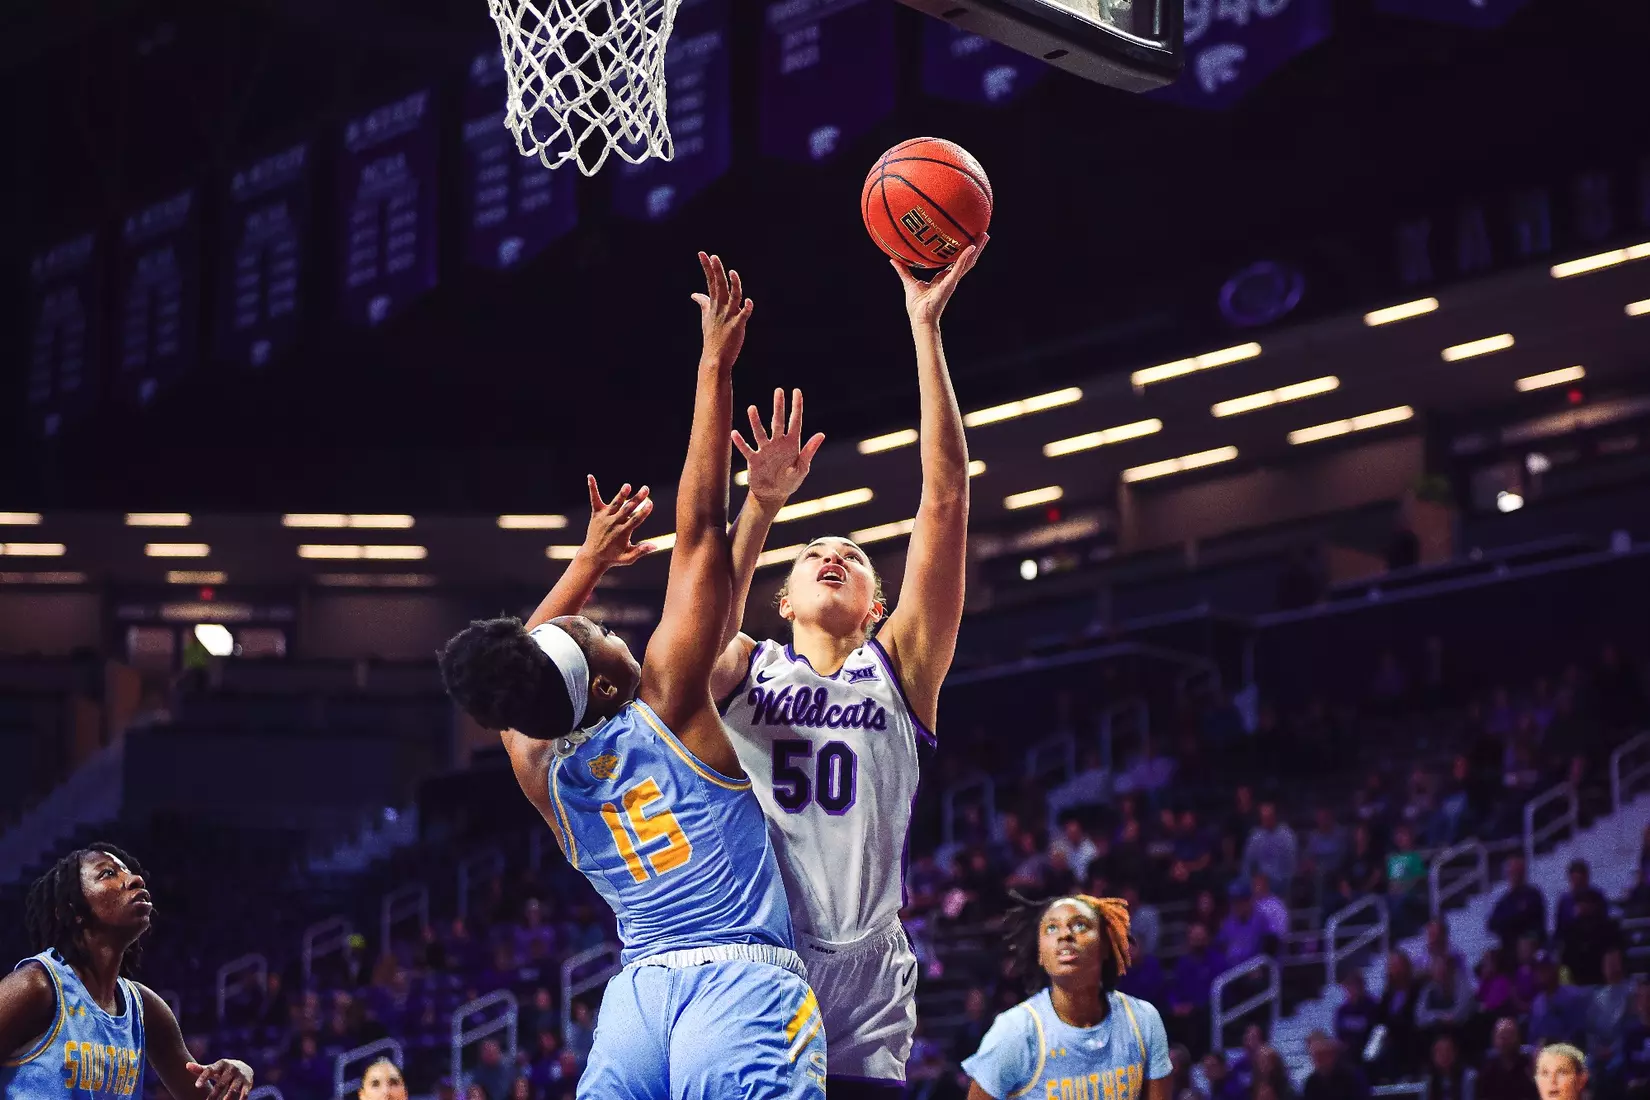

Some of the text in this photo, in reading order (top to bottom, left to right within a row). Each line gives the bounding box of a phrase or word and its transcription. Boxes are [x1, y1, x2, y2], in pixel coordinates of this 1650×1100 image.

[900, 208, 960, 259] ELITE
[748, 684, 887, 731] Wildcats
[772, 739, 857, 816] 50
[600, 776, 693, 884] 15
